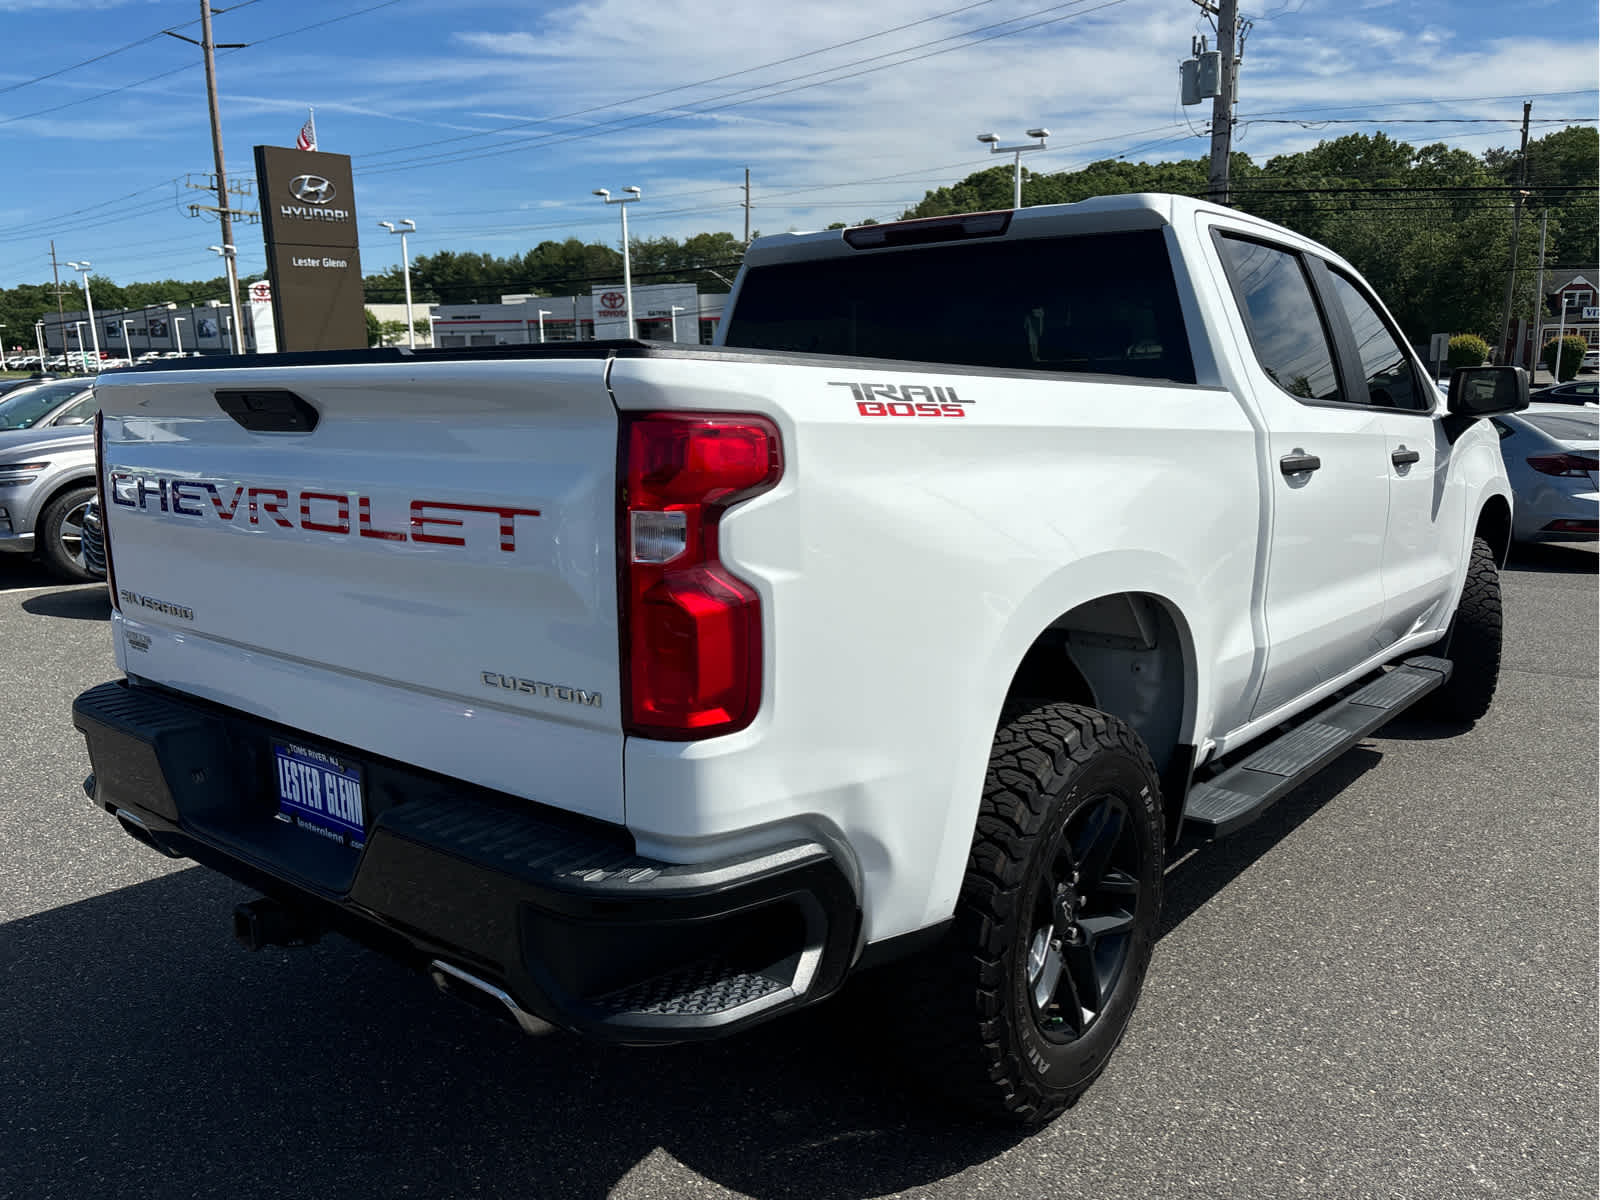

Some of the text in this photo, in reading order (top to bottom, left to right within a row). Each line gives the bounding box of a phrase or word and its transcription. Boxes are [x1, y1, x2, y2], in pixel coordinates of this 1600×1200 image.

[281, 205, 349, 222] HYUNDAI
[292, 256, 348, 268] Lester Glenn
[827, 381, 976, 403] TRAIL
[856, 401, 965, 417] BOSS
[111, 472, 541, 552] CHEVROLET
[120, 590, 193, 620] SILVERADO
[481, 670, 602, 708] CUSTOM
[278, 757, 364, 827] LESTER GLENN
